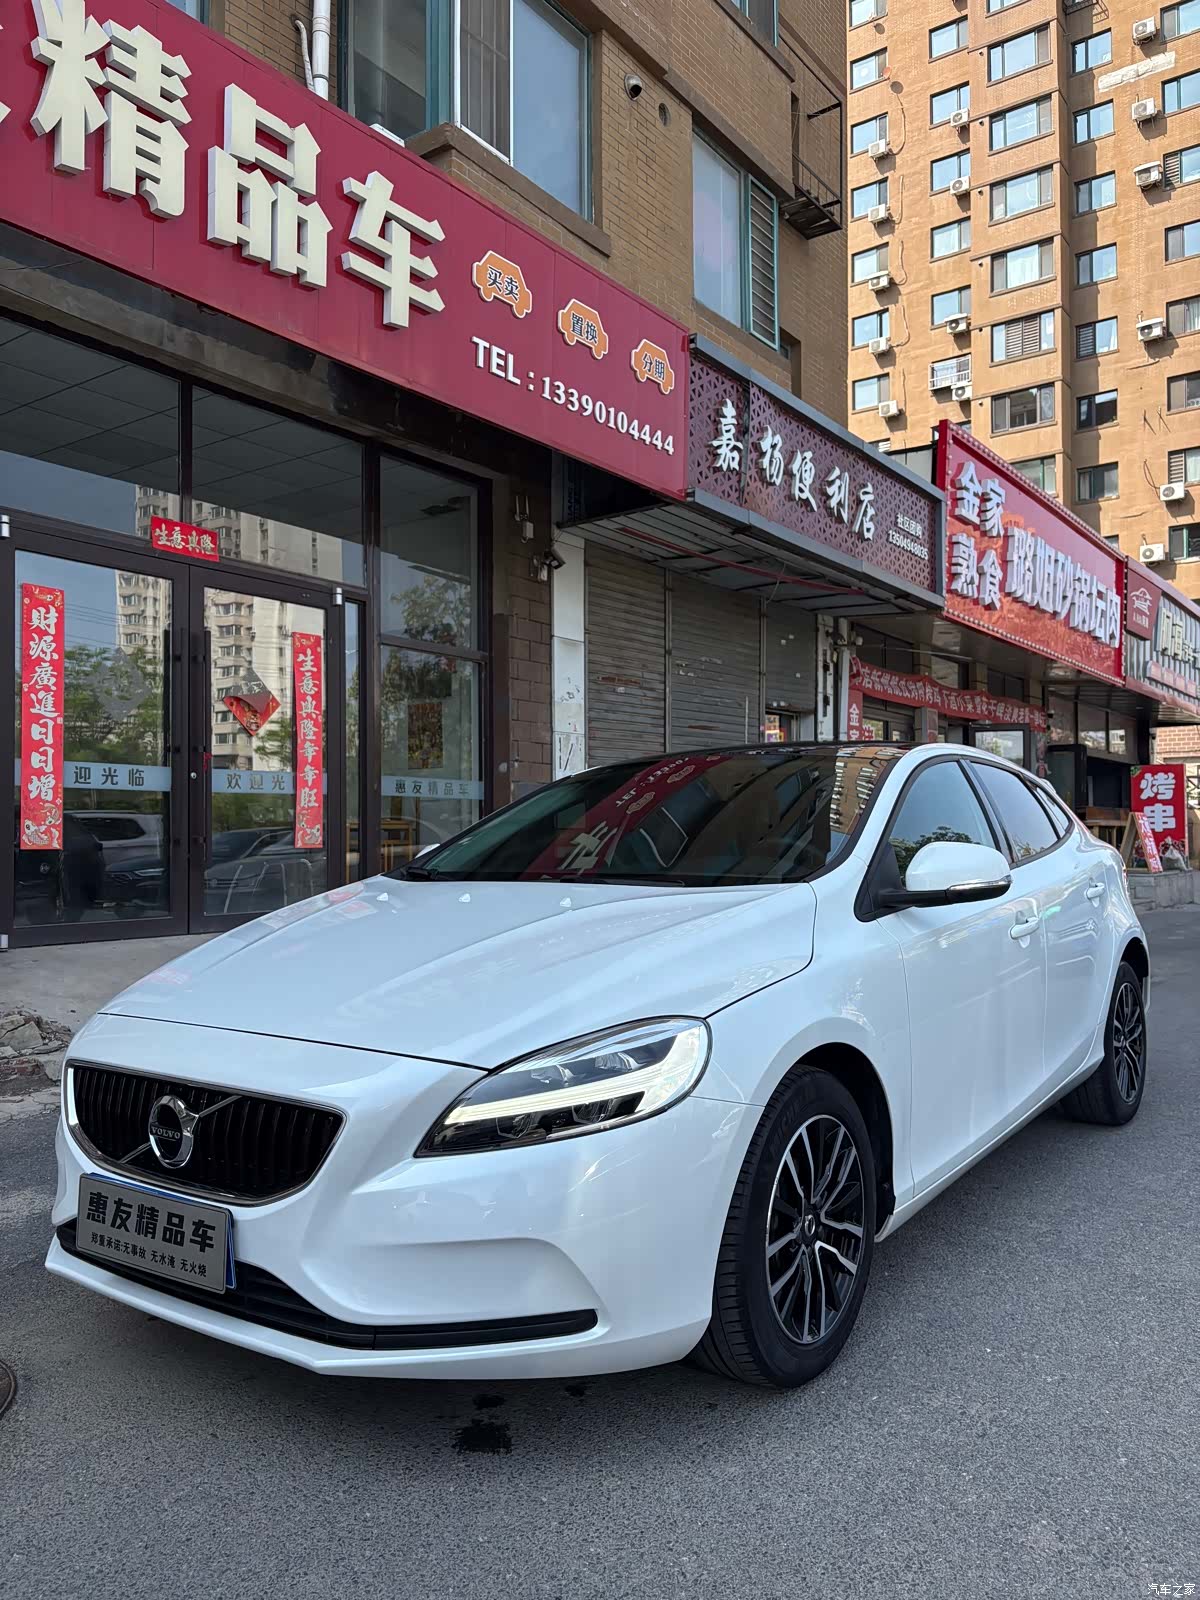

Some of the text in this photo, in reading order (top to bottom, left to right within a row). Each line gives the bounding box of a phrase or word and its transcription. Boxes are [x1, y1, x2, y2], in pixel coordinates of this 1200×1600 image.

[0, 0, 445, 328] 精品车
[487, 265, 519, 301] 买卖
[571, 312, 598, 345] 置换
[642, 352, 666, 381] 分期
[954, 461, 1006, 537] 金家
[226, 772, 297, 791] 欢迎光
[395, 779, 470, 796] 惠友精品车
[1140, 771, 1176, 832] 烤串
[151, 1126, 180, 1140] VOLVO
[86, 1191, 216, 1253] 惠友精品车
[180, 1258, 207, 1278] 无火烧
